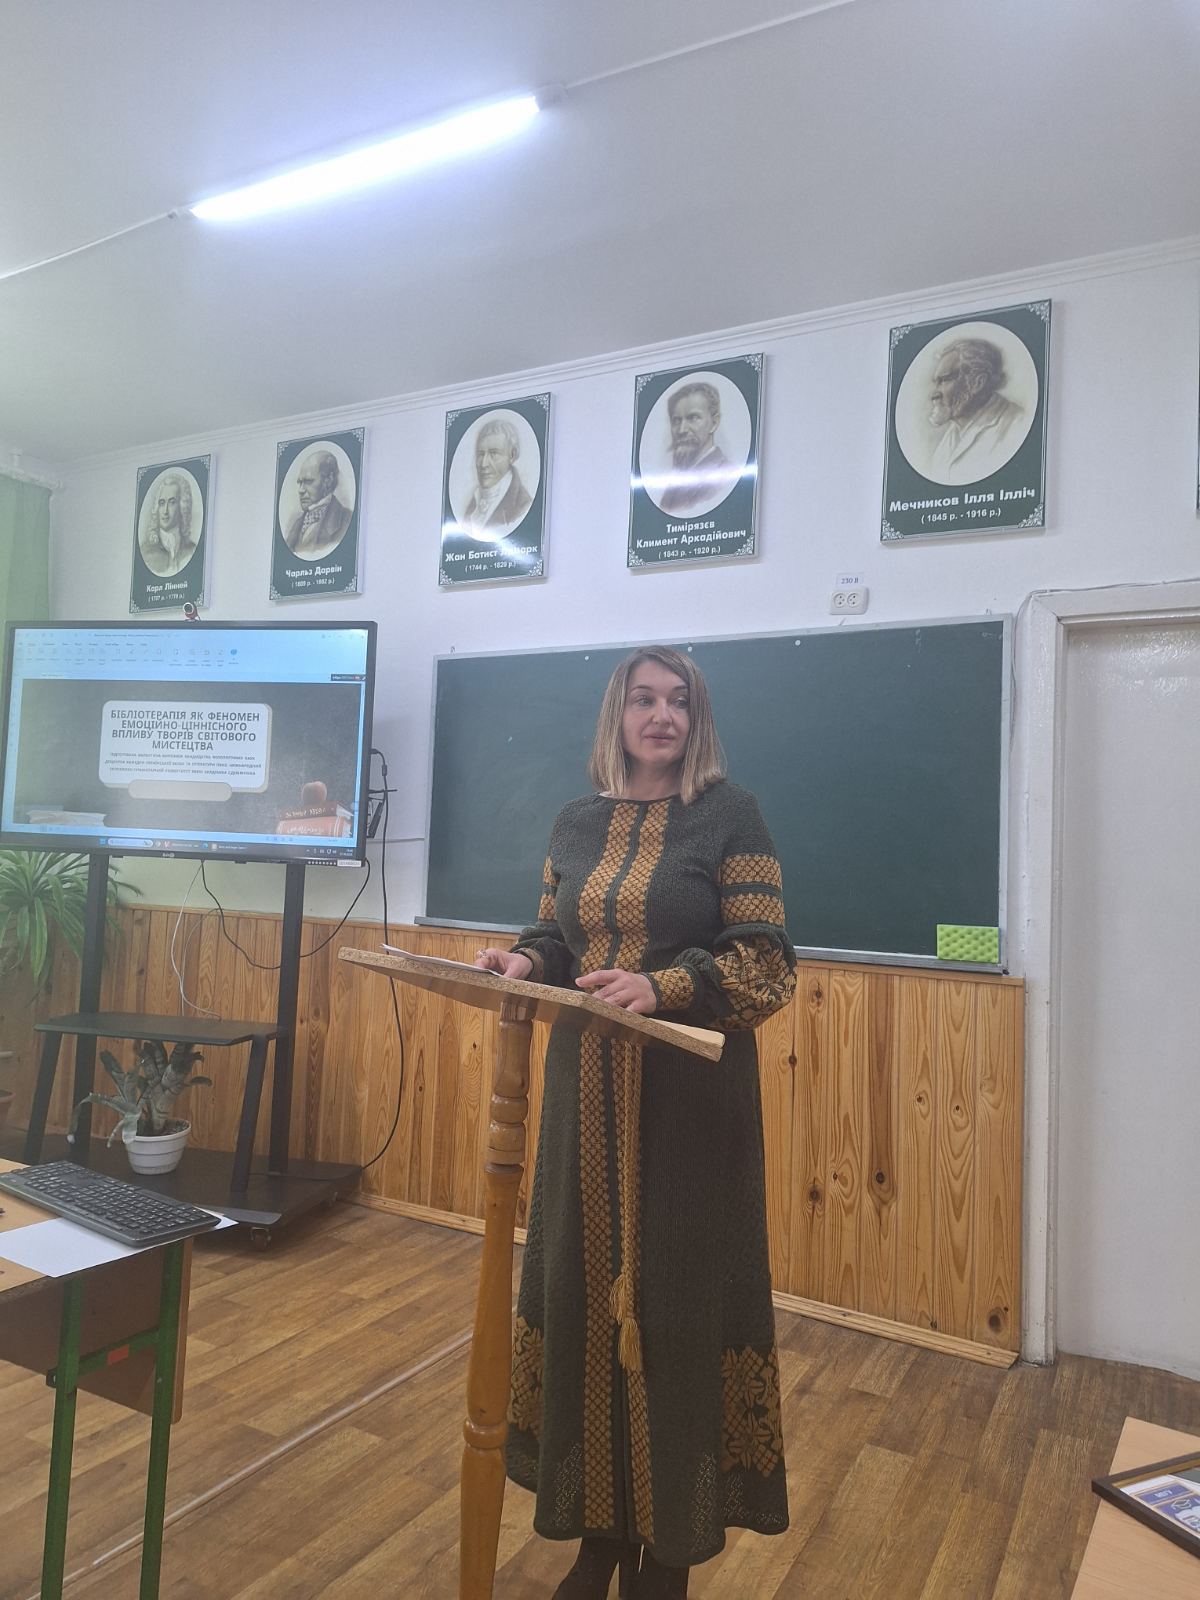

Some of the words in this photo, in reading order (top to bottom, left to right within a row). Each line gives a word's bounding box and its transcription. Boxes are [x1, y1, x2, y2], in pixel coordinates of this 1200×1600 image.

[889, 496, 959, 513] Мечников
[964, 492, 995, 504] Ілля
[1000, 486, 1036, 501] Ілліч
[966, 508, 987, 518] 1916
[666, 521, 715, 534] Тимірязєв
[636, 536, 678, 548] Климент
[680, 530, 746, 546] Аркадійович
[445, 553, 466, 562] Жан
[468, 550, 498, 560] Батист
[694, 546, 710, 555] 1920
[286, 569, 312, 578] Чарльз
[314, 564, 342, 576] Дарвін
[146, 584, 163, 593] Карл
[110, 710, 186, 720] БІБЛІОТЕРАПІЯ
[190, 711, 203, 721] ЯК
[207, 712, 260, 721] ФЕНОМЕН
[112, 729, 154, 739] ВПЛИВУ
[157, 730, 194, 740] ТВОРІВ
[197, 732, 256, 742] СВІТОВОГО
[152, 740, 214, 752] МИСТЕЦТВА
